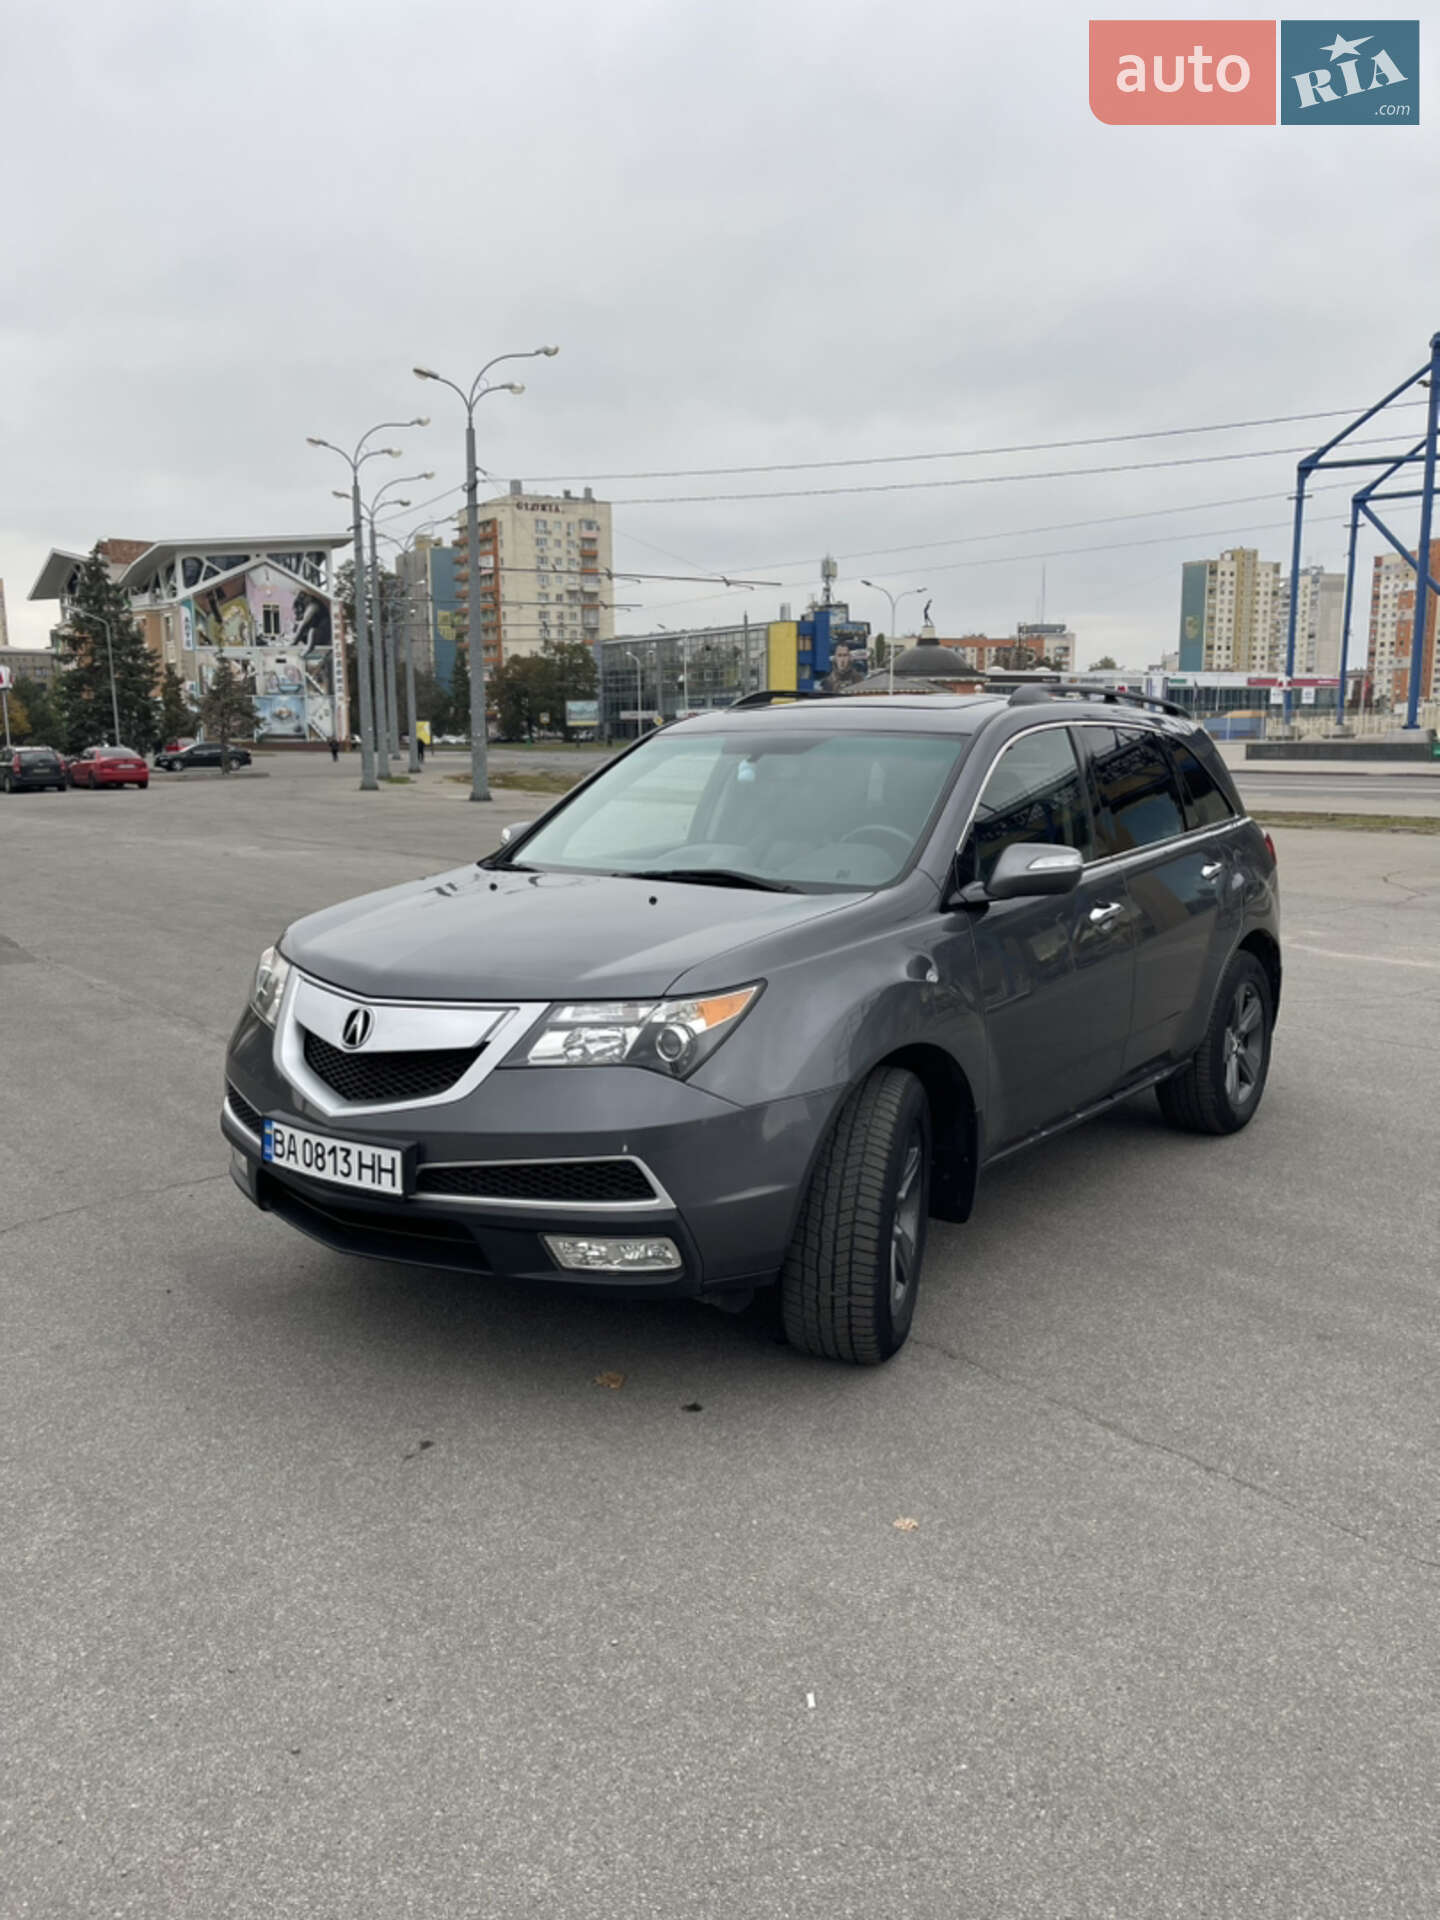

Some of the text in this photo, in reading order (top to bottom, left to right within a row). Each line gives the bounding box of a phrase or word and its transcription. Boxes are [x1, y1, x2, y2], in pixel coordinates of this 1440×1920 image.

[273, 1128, 396, 1188] BA 0813 HH
